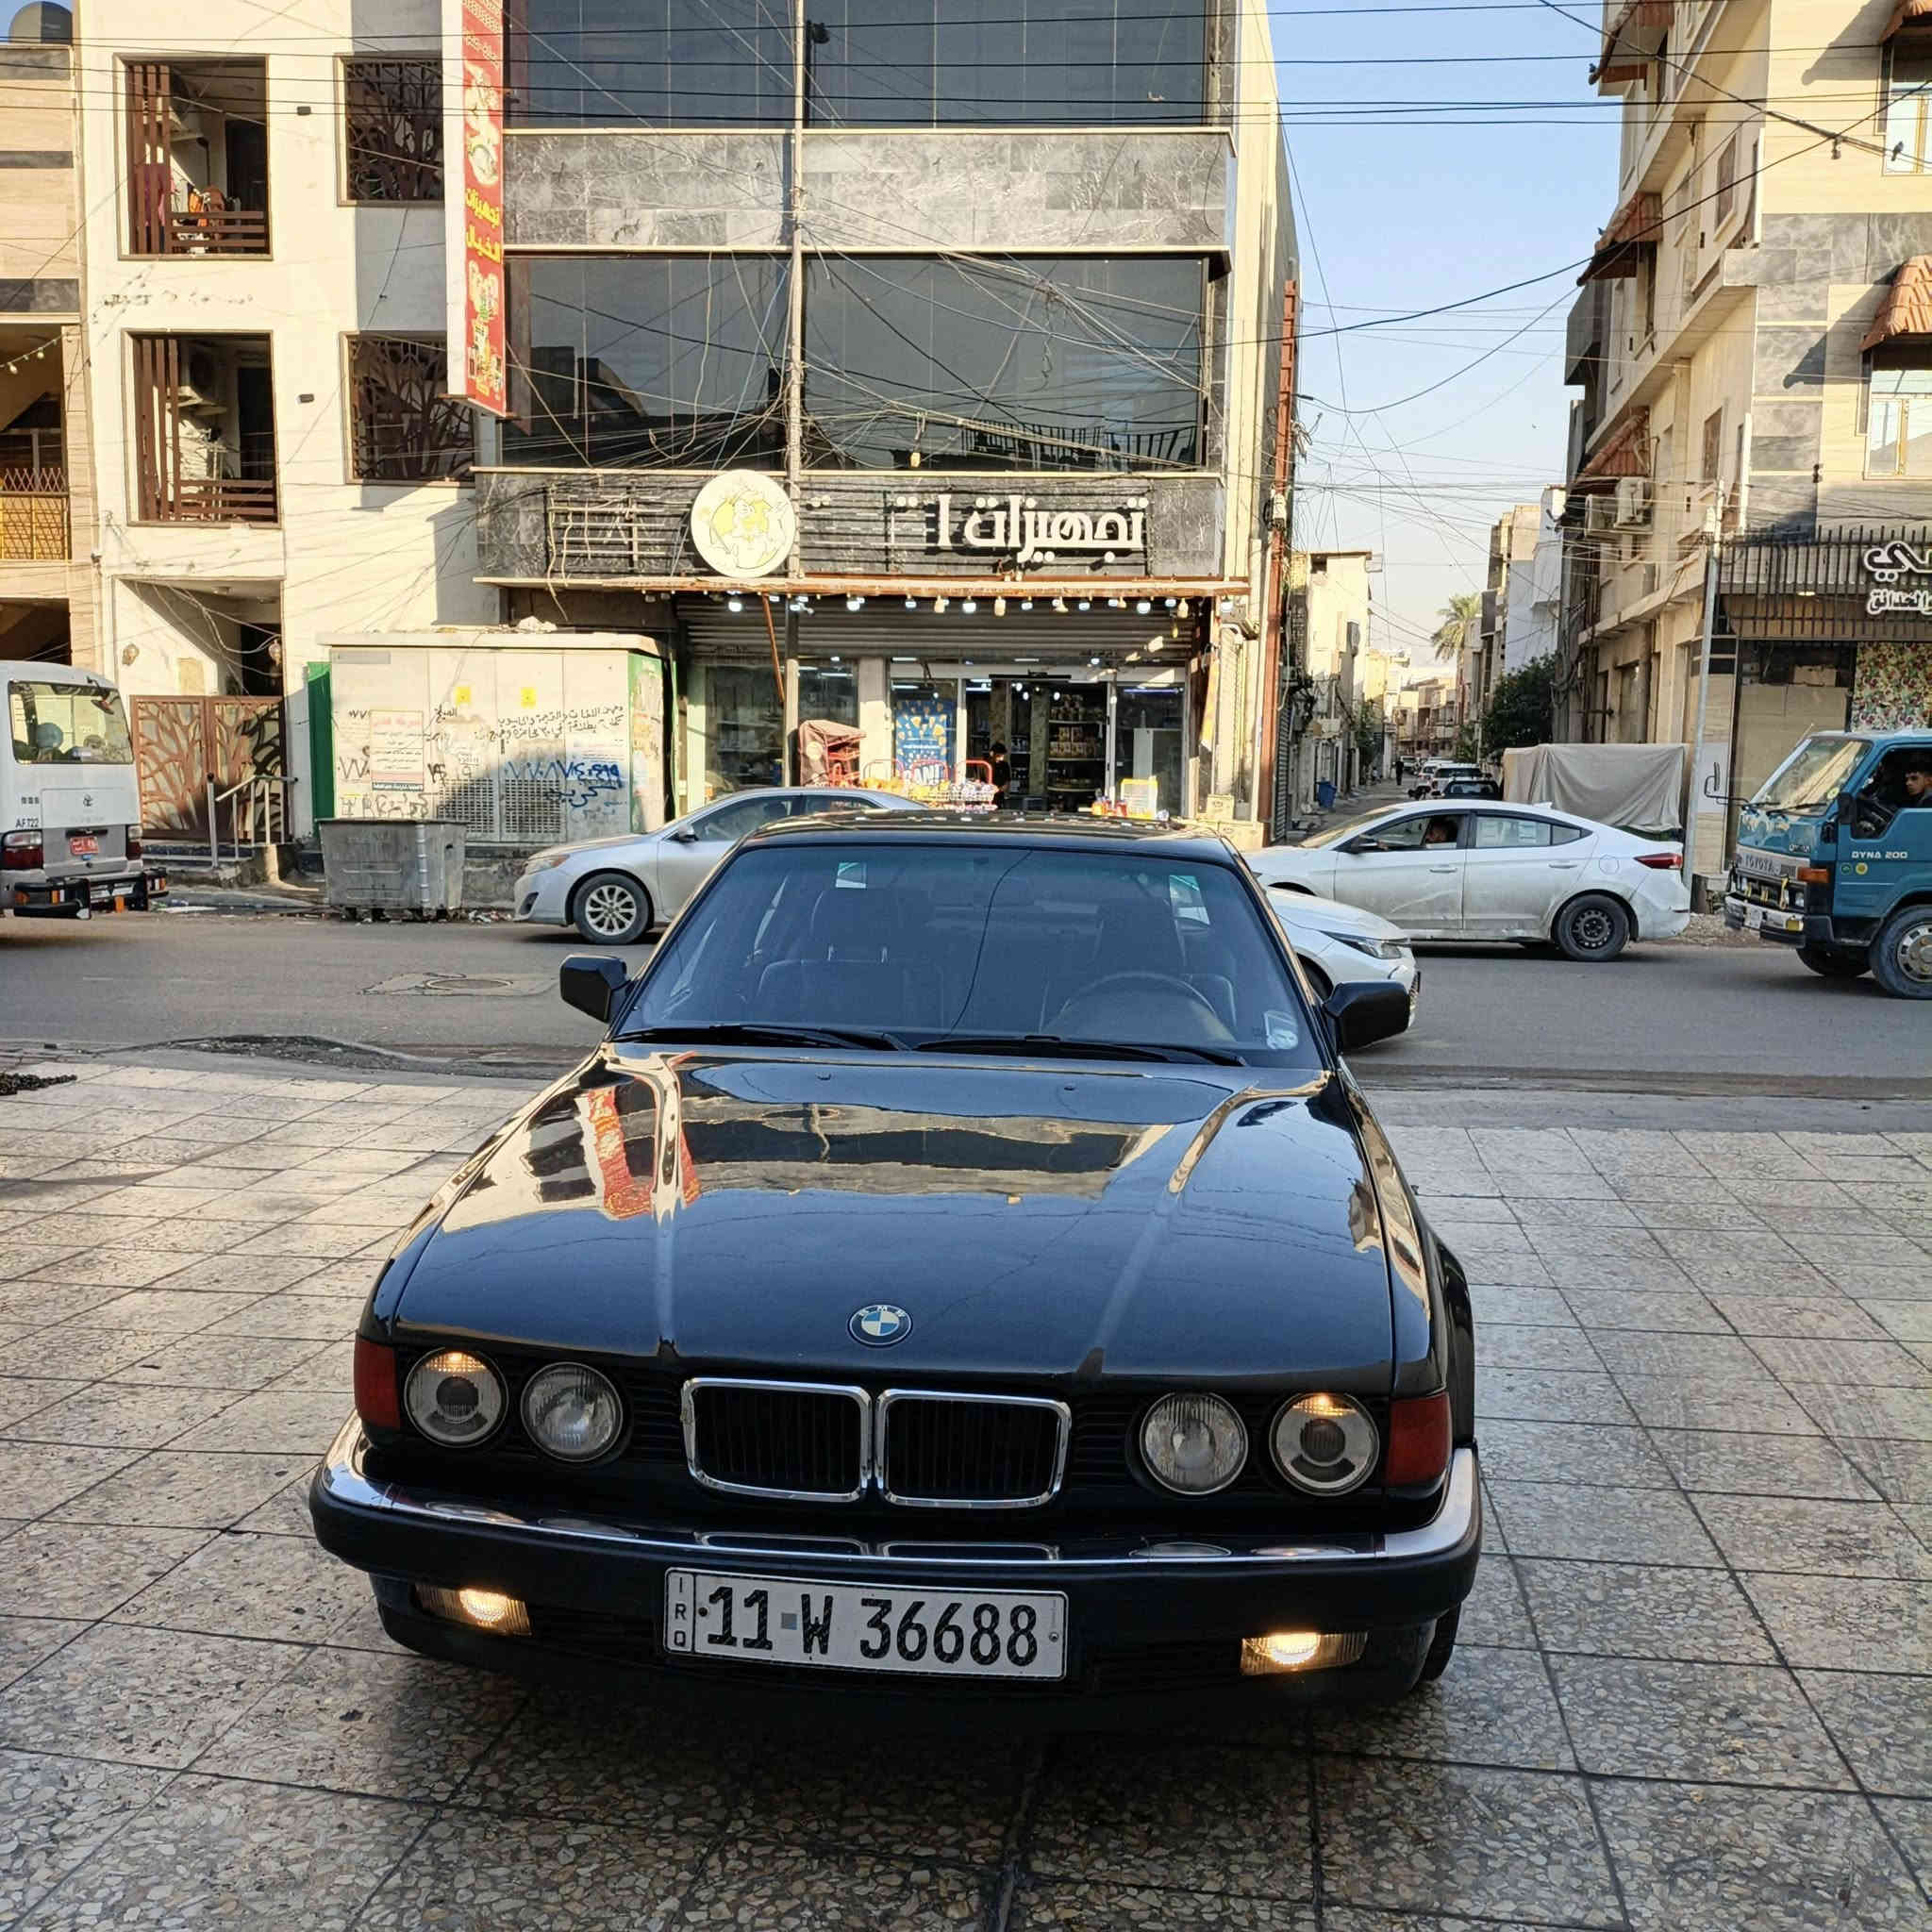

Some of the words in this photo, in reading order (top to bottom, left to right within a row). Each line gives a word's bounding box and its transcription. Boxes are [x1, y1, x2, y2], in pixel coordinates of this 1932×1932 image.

[963, 495, 1149, 563] تجهيزات
[1851, 850, 1882, 859] DYNA
[707, 1586, 774, 1651] 11
[801, 1592, 835, 1655] W
[858, 1598, 1039, 1668] 36688
